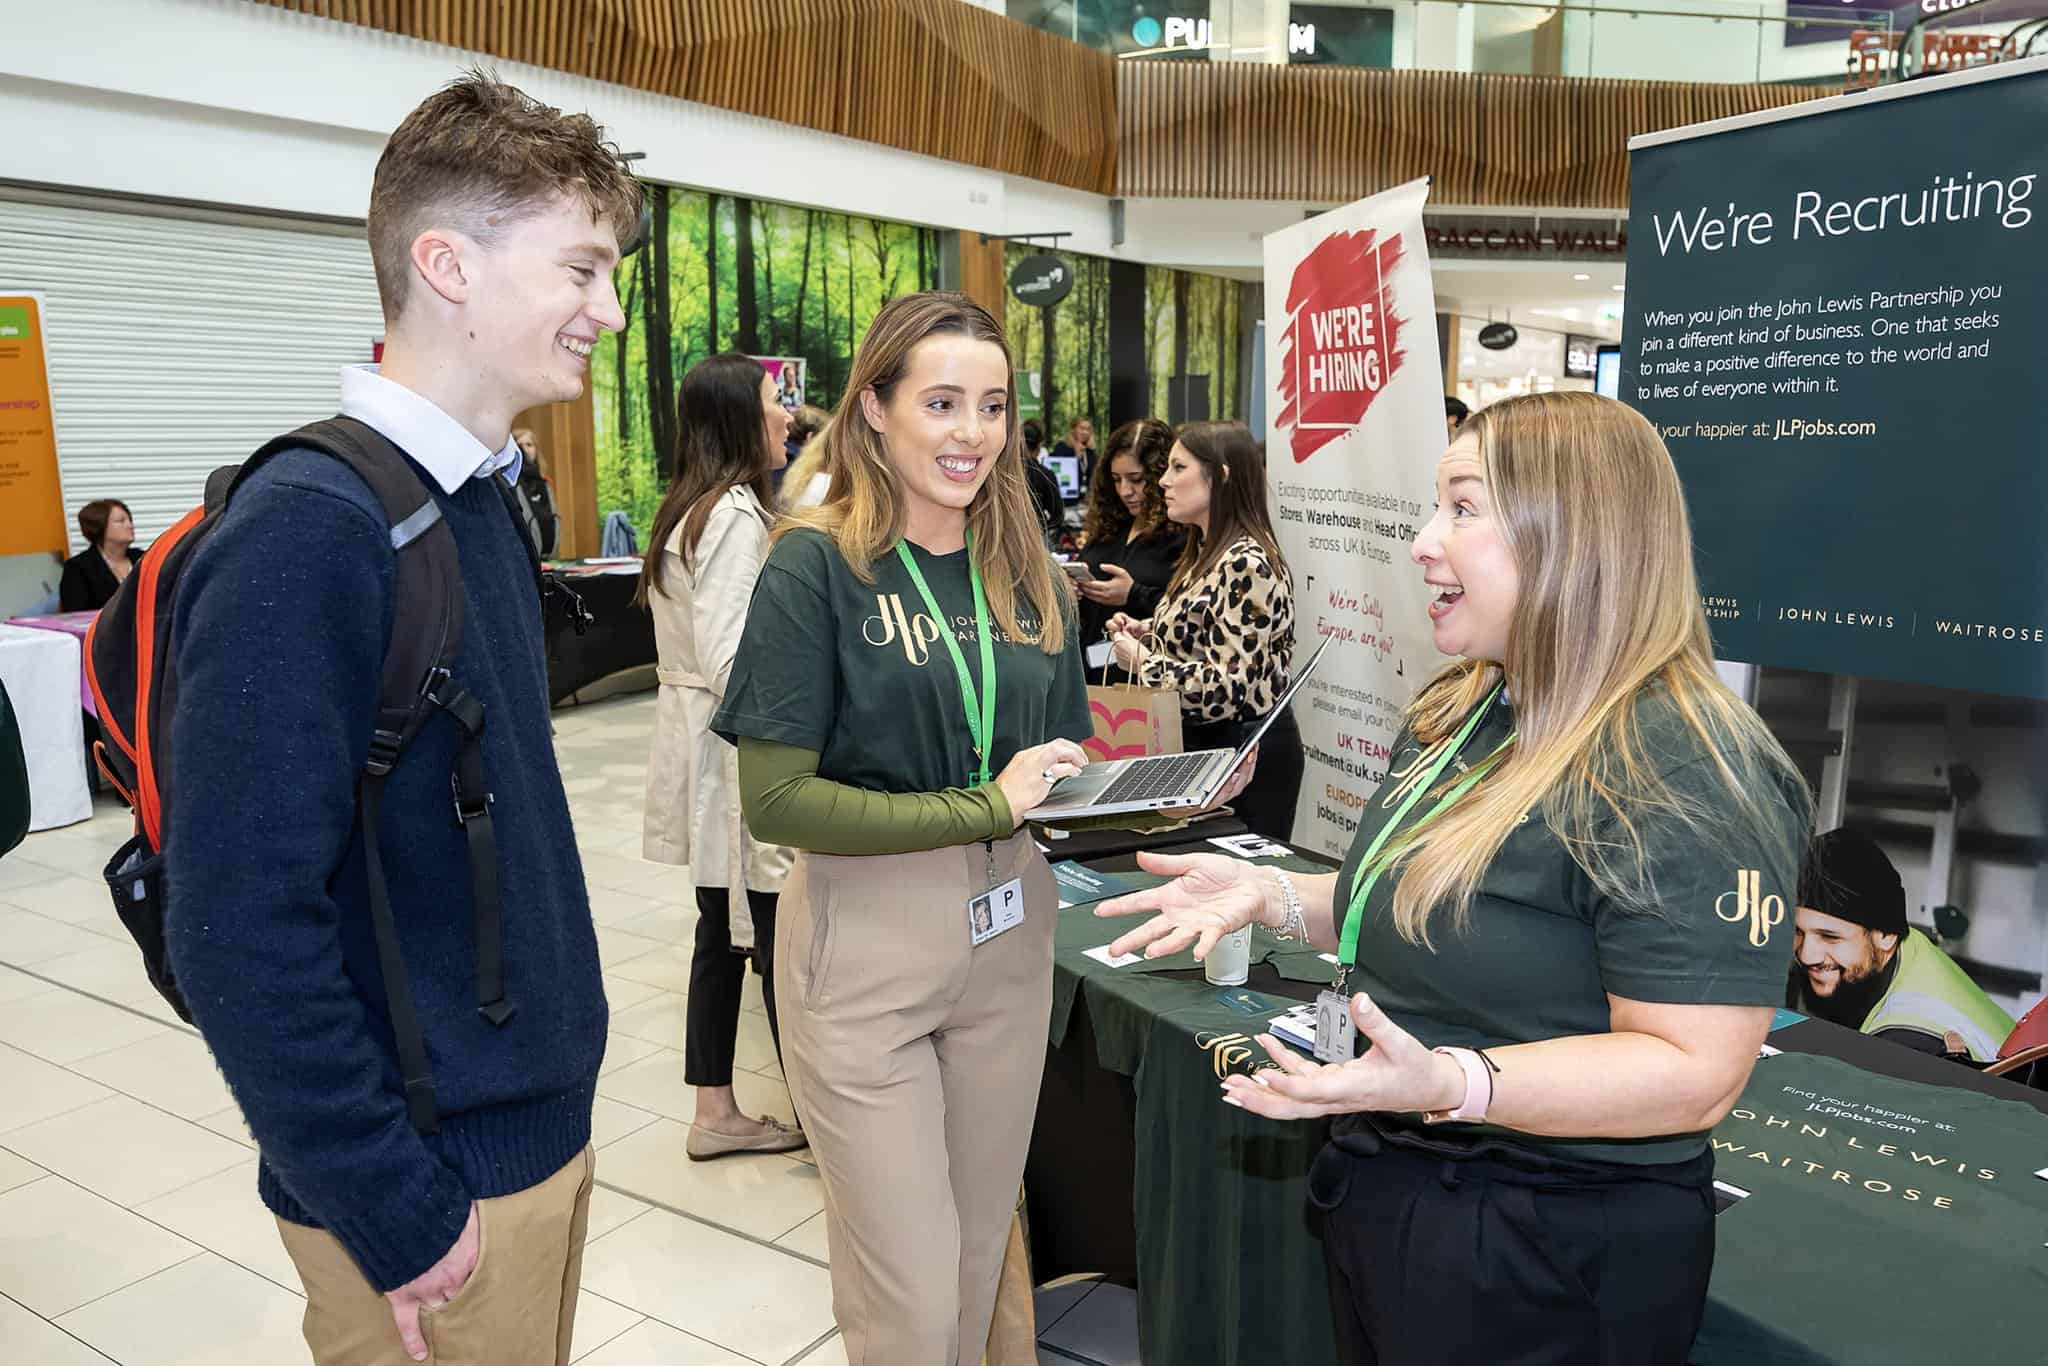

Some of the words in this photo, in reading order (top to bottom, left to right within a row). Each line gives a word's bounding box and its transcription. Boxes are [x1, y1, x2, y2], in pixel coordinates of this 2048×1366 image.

[1653, 203, 1773, 256] We're
[1792, 171, 2038, 240] Recruiting
[1644, 310, 1684, 328] When
[1687, 310, 1714, 329] you
[1716, 304, 1743, 327] join
[1748, 301, 1773, 319] the
[1774, 298, 1812, 321] John
[1817, 295, 1864, 313] Lewis
[1869, 285, 1964, 309] Partnership
[1968, 284, 2002, 307] you
[1310, 302, 1376, 351] WE'RE
[1640, 336, 1663, 357] join
[1666, 338, 1675, 350] a
[1678, 330, 1734, 350] different
[1738, 326, 1770, 345] kind
[1773, 324, 1792, 343] of
[1795, 324, 1864, 341] business.
[1871, 317, 1910, 337] One
[1915, 314, 1949, 334] that
[1953, 309, 2000, 332] seeks
[1308, 349, 1381, 393] HIRING
[1640, 361, 1653, 376] to
[1656, 357, 1691, 375] make
[1694, 359, 1702, 372] a
[1705, 354, 1760, 377] positive
[1764, 350, 1841, 370] difference
[1846, 349, 1864, 366] to
[1870, 345, 1898, 364] the
[1903, 340, 1953, 361] world
[1957, 338, 1990, 359] and
[1638, 385, 1650, 400] to
[1653, 383, 1680, 399] lives
[1683, 380, 1700, 398] of
[1701, 381, 1768, 400] everyone
[1772, 376, 1820, 394] within
[1825, 375, 1840, 393] it.
[1661, 425, 1692, 440] your
[1694, 421, 1748, 441] happier
[1751, 422, 1770, 437] at:
[1772, 418, 1877, 441] JLPjobs.com
[1306, 508, 1361, 530] Warehouse
[1374, 519, 1396, 539] Head
[1308, 535, 1341, 552] across
[1342, 537, 1359, 554] UK
[1328, 585, 1360, 612] We're
[1702, 596, 1738, 608] LEWIS
[1778, 606, 1828, 623] JOHN
[1834, 611, 1895, 629] LEWIS
[1935, 619, 2045, 643] WAITROSE
[1336, 732, 1354, 751] UK
[1003, 889, 1014, 907] P
[1339, 1012, 1347, 1034] P
[1781, 1084, 1817, 1100] Find
[1819, 1094, 1860, 1111] your
[1863, 1101, 1931, 1126] happier
[1804, 1101, 1918, 1135] JLPjobs.com
[1731, 1108, 1828, 1139] OHN
[1847, 1136, 1997, 1181] LEWIS
[1710, 1137, 1953, 1209] WAITROSE
